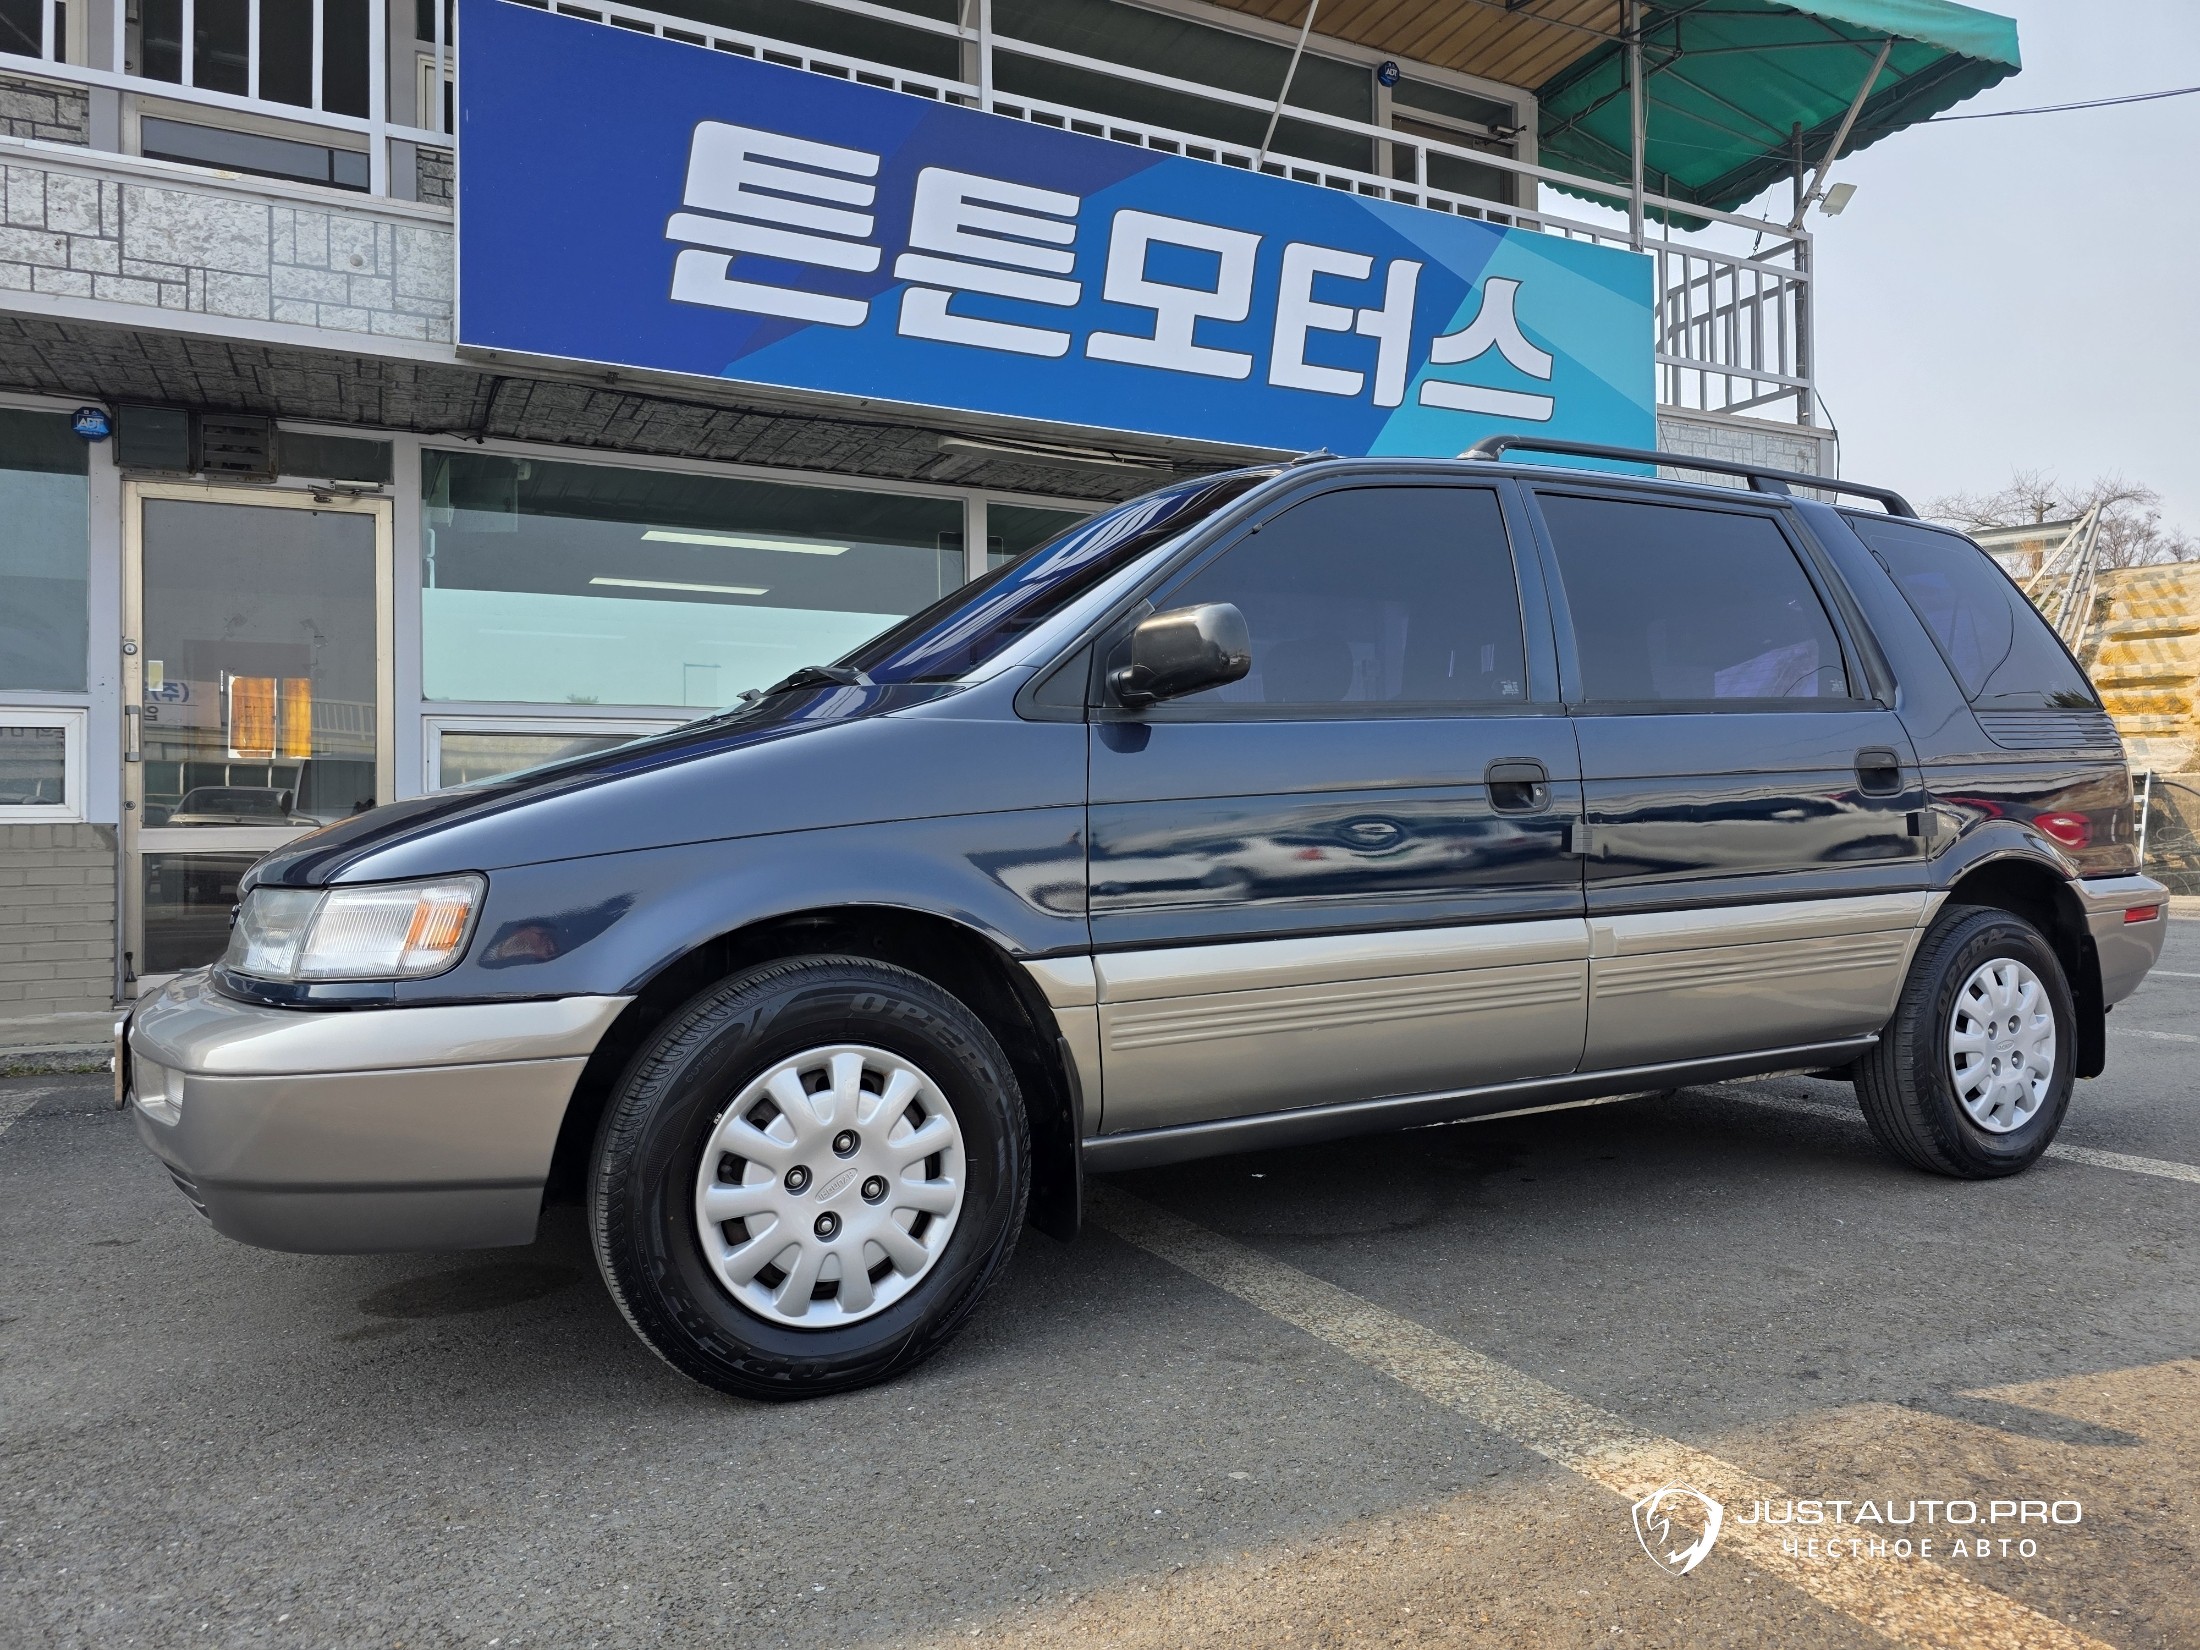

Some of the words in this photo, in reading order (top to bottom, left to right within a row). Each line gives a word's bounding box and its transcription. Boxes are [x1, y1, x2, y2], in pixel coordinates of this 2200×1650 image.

[1385, 68, 1398, 77] ADT
[665, 120, 1554, 421] 튼튼모터스
[78, 417, 104, 429] ADT
[685, 1039, 727, 1084] OUTSIDE
[849, 991, 1007, 1119] OPERA
